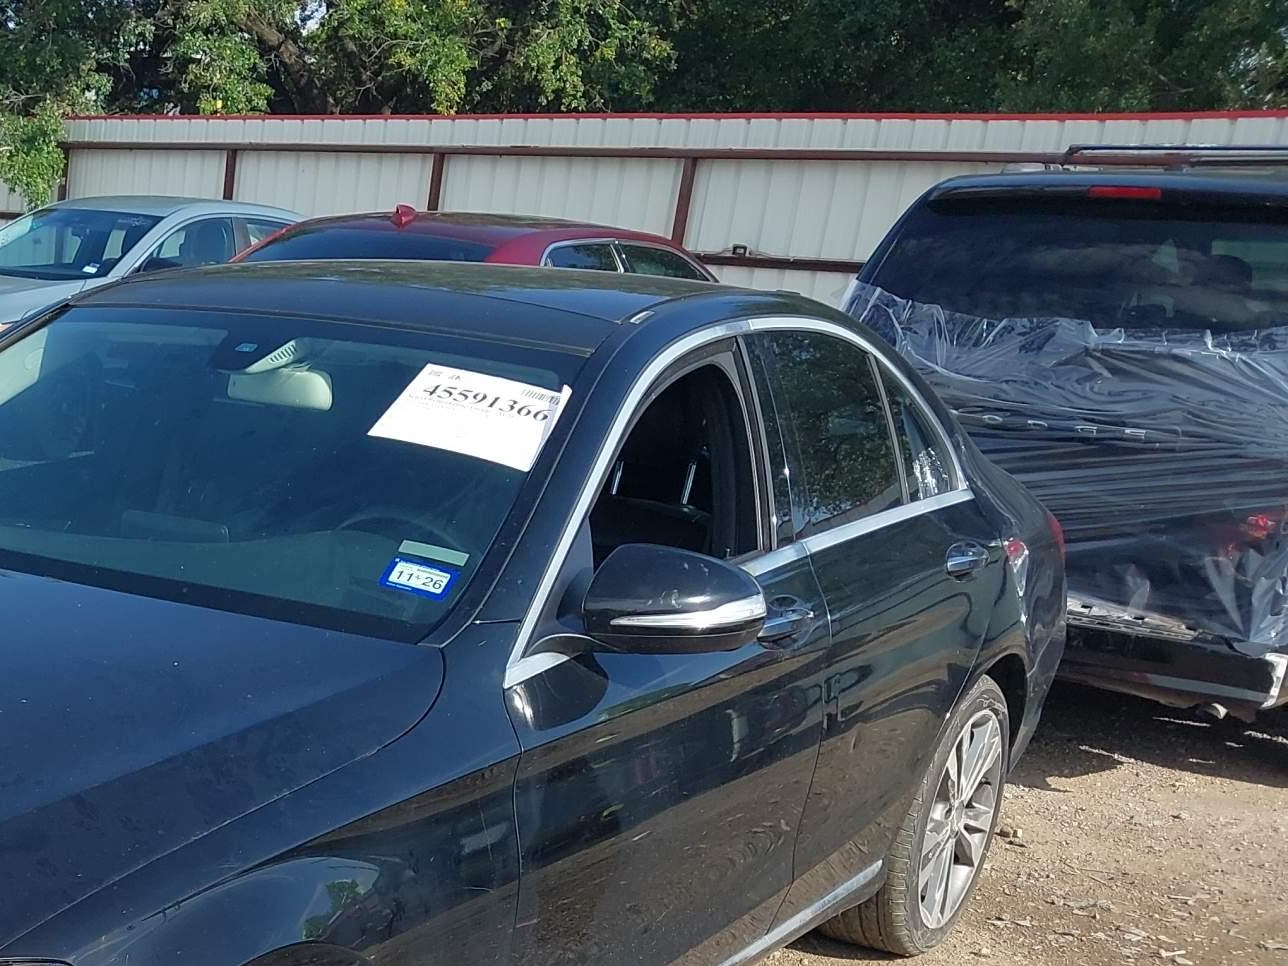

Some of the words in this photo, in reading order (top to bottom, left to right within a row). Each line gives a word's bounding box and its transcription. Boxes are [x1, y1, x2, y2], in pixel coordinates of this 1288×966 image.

[422, 383, 553, 423] 45591366
[395, 570, 414, 583] 11
[421, 576, 444, 590] 26
